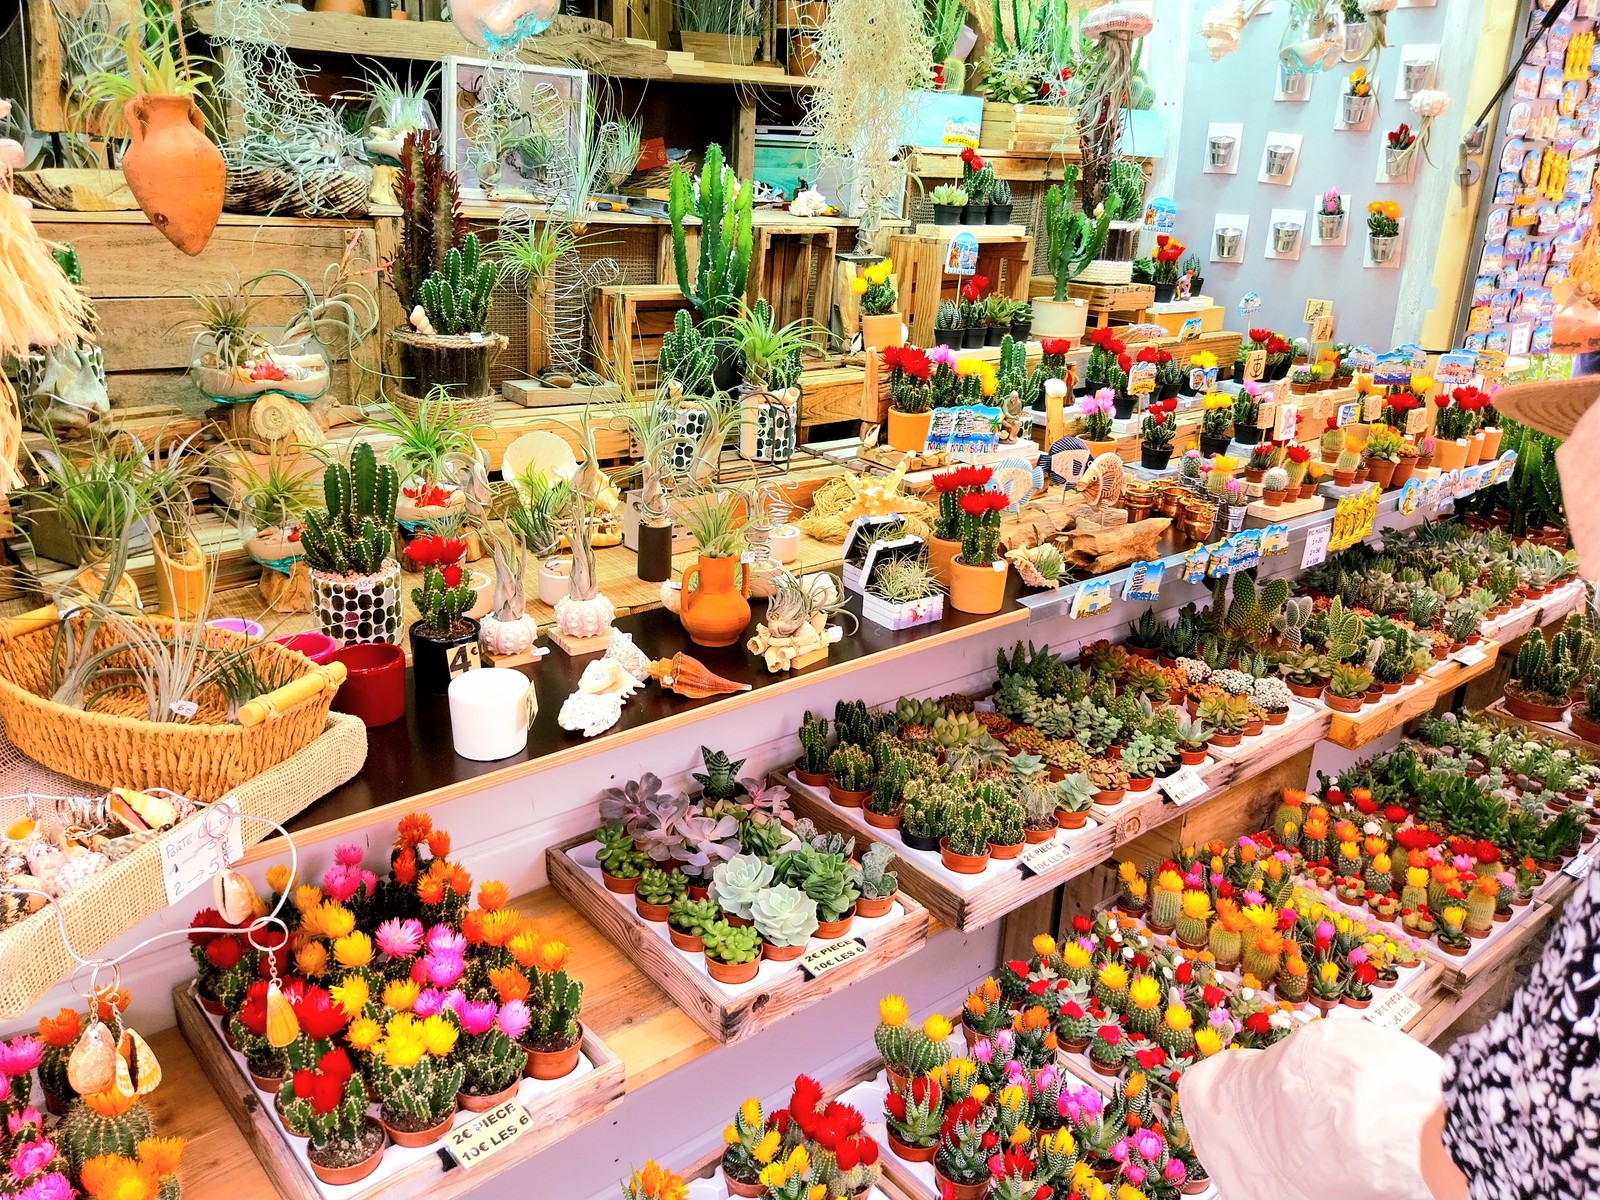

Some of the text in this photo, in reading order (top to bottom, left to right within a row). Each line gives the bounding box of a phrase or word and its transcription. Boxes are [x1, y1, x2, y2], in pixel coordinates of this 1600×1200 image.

[165, 832, 194, 859] PORTE
[1034, 841, 1058, 856] PIECE
[1047, 853, 1064, 864] LES
[173, 855, 220, 896] 2 5
[804, 939, 853, 963] 2€ PIECE
[813, 959, 835, 972] 10€
[833, 950, 856, 963] LES
[452, 1128, 473, 1146] 2€
[461, 1114, 529, 1162] 10€ LES 6
